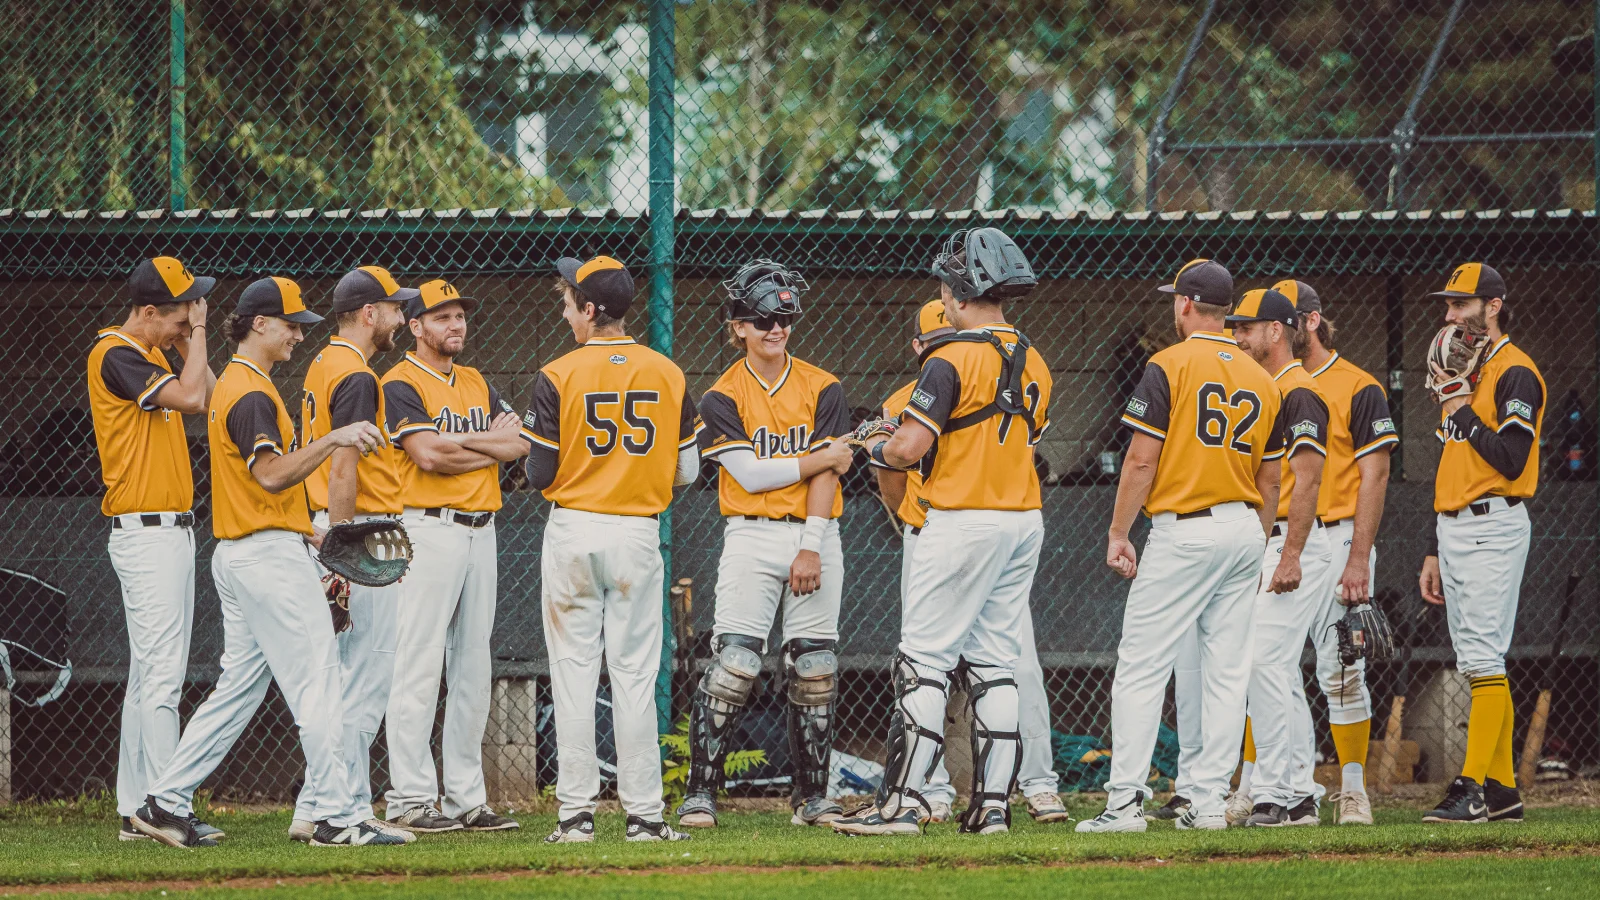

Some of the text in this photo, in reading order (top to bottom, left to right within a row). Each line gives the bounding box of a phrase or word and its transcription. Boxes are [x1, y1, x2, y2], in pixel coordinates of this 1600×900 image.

[584, 390, 659, 457] 55
[750, 423, 815, 459] Apoll
[1196, 381, 1262, 456] 62
